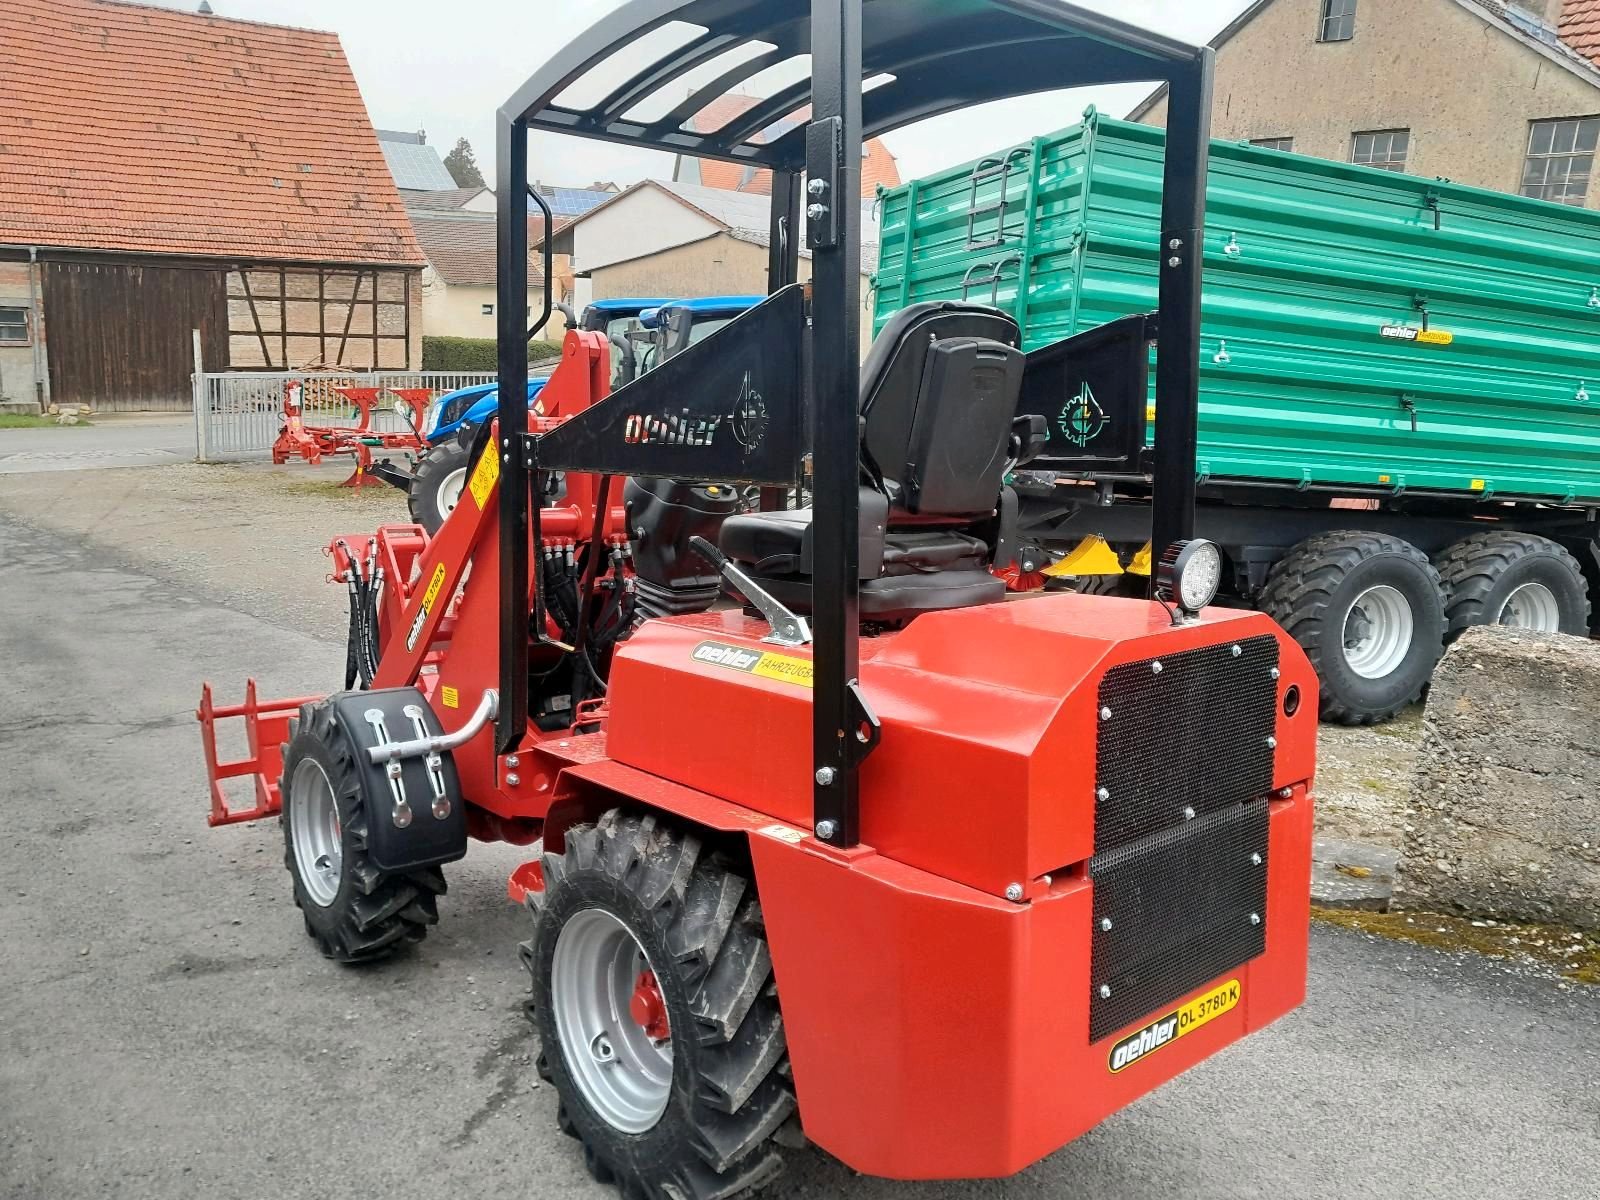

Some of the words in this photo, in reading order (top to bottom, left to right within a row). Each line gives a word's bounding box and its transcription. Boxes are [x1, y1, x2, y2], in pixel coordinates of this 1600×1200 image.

[1382, 327, 1417, 339] oehler
[407, 607, 427, 651] oehler
[430, 574, 441, 598] 3780
[694, 645, 759, 669] oehler
[1112, 1018, 1178, 1070] oehler
[1180, 1009, 1196, 1028] OL
[1198, 991, 1227, 1018] 3780
[1229, 985, 1237, 1002] K
